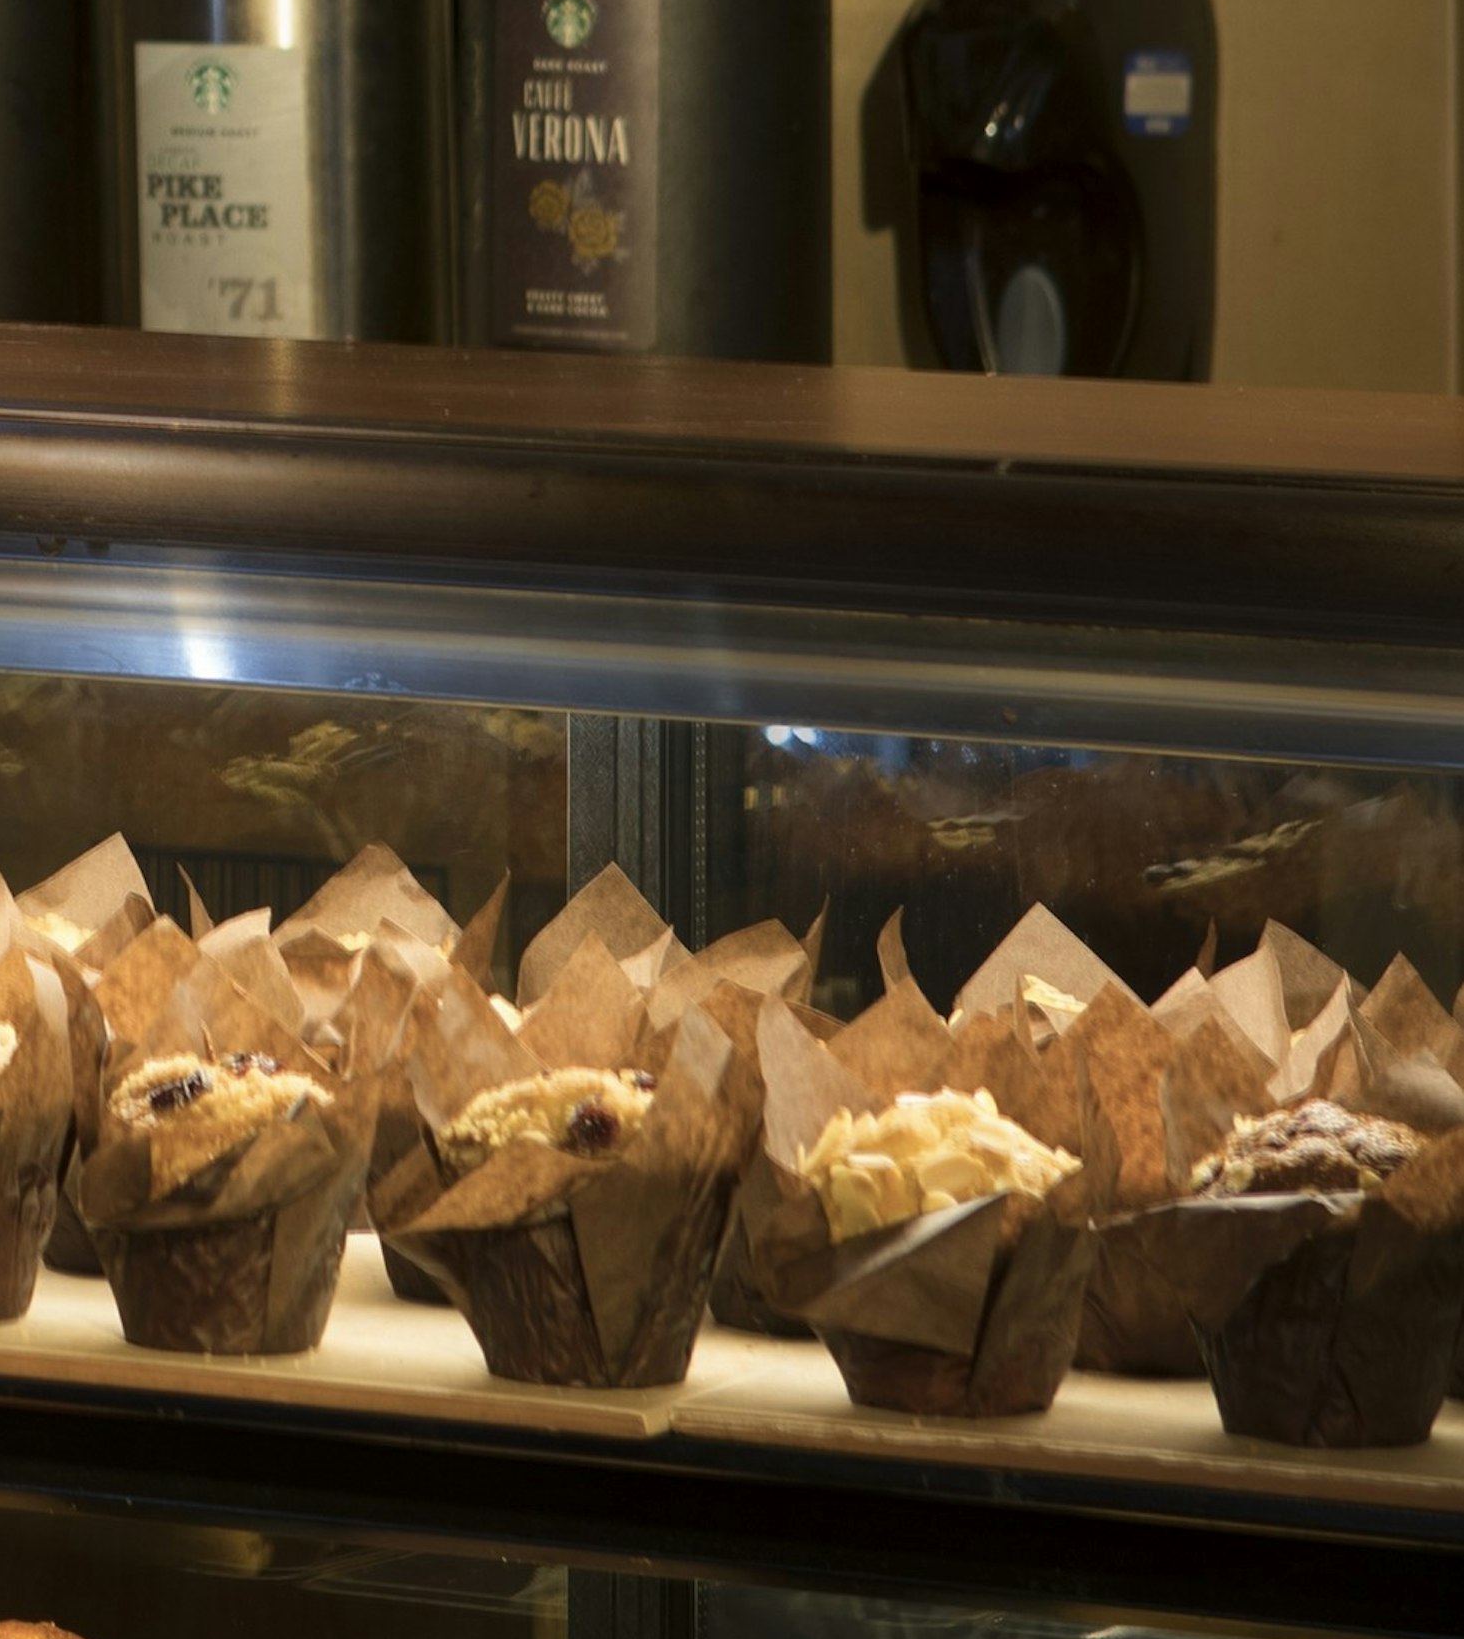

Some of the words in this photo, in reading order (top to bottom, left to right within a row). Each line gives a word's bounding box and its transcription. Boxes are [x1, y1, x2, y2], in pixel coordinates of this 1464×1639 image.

[512, 112, 629, 165] VERONA
[147, 173, 224, 200] PIKE
[160, 202, 268, 230] PLACE
[151, 232, 226, 246] ROAST
